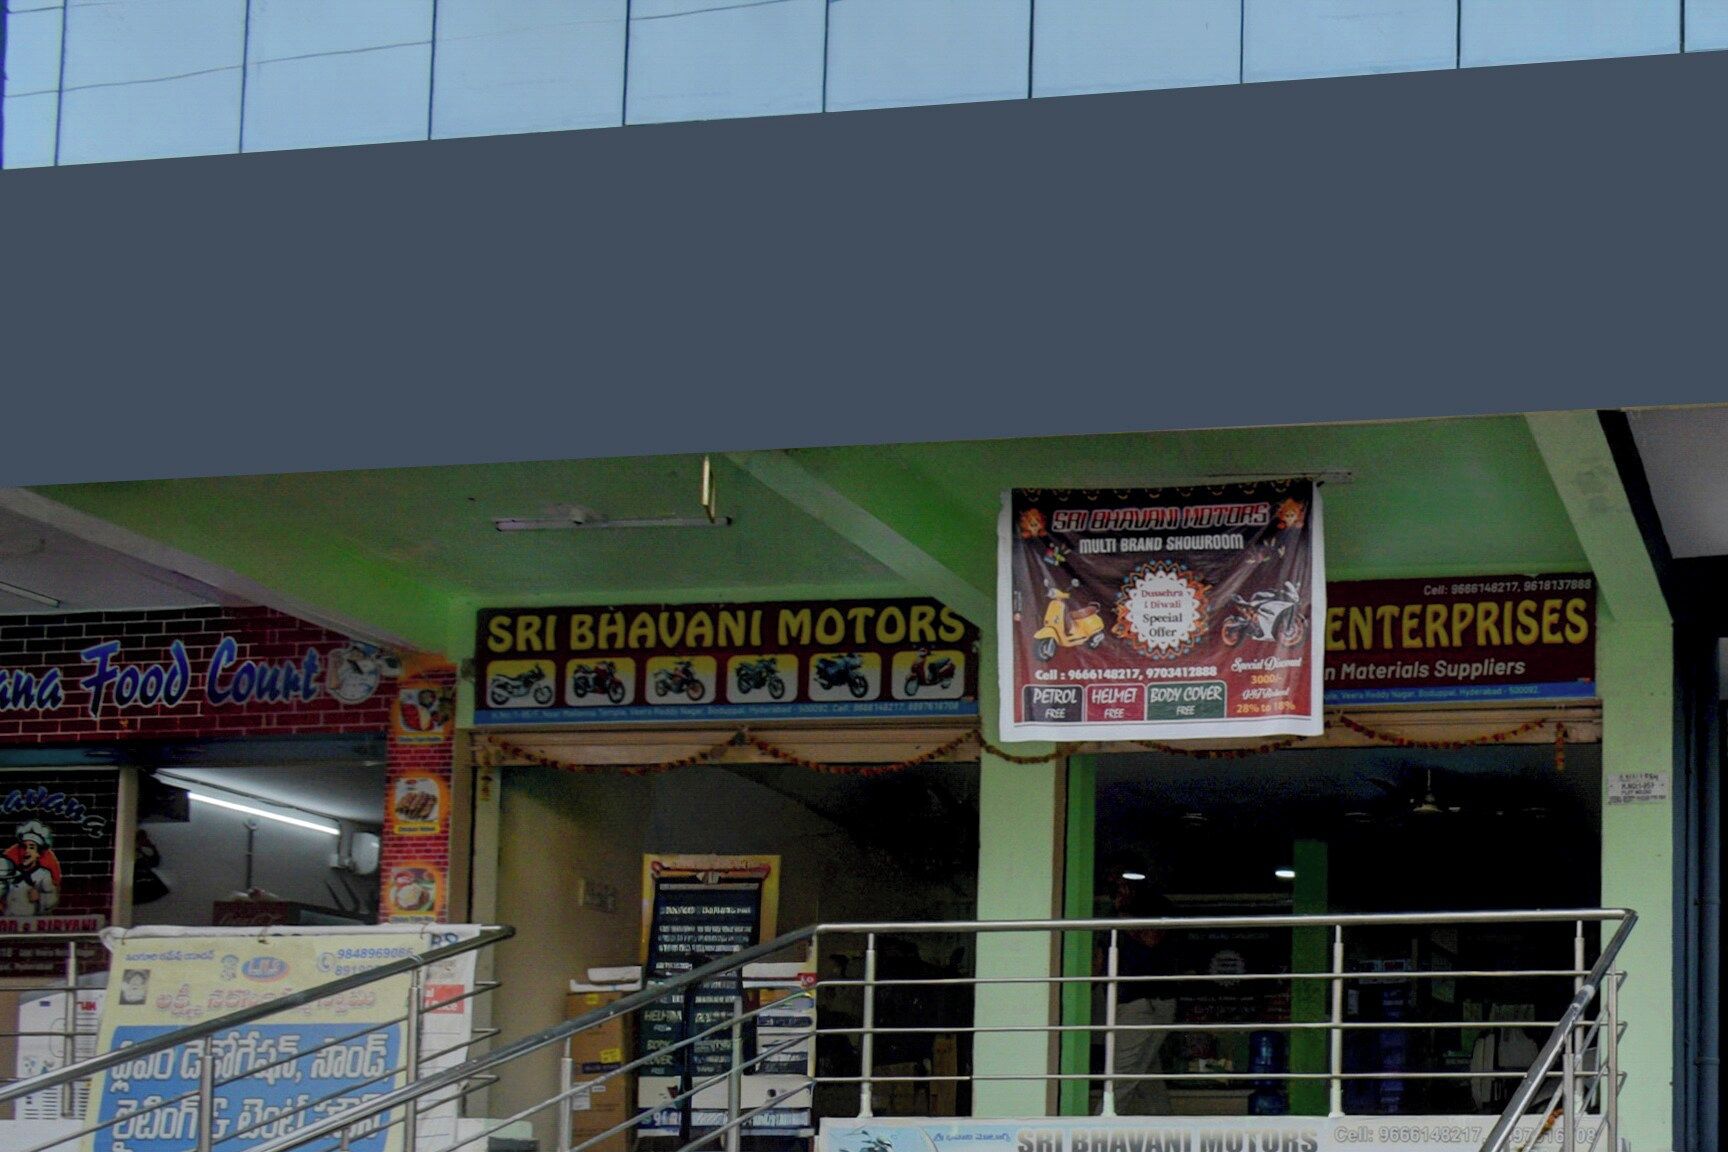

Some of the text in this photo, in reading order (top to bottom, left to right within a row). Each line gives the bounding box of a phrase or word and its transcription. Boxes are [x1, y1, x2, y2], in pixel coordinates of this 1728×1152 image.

[1052, 502, 1270, 532] SRI BHAVANI MOTORS
[1079, 534, 1244, 554] MULTI BRAND SHOWROOM
[1423, 584, 1449, 596] Cell:
[1143, 613, 1183, 626] Special
[1326, 597, 1590, 651] ENTERPRISES
[487, 606, 966, 652] SRI BHAVANI MOTORS
[1149, 628, 1177, 637] Offer
[80, 640, 191, 719] Food
[206, 636, 320, 705] Court
[1341, 661, 1429, 680] Materials
[1434, 659, 1525, 680] Suppliers
[1032, 688, 1077, 704] PETROL
[1092, 688, 1137, 703] HELMET
[1150, 686, 1223, 703] BODY COVER
[1045, 708, 1066, 719] FREE
[1104, 708, 1125, 719] FREE
[1176, 705, 1196, 717] FREE
[1334, 1126, 1374, 1144] Cell:
[1379, 1126, 1487, 1145] 9666148217,
